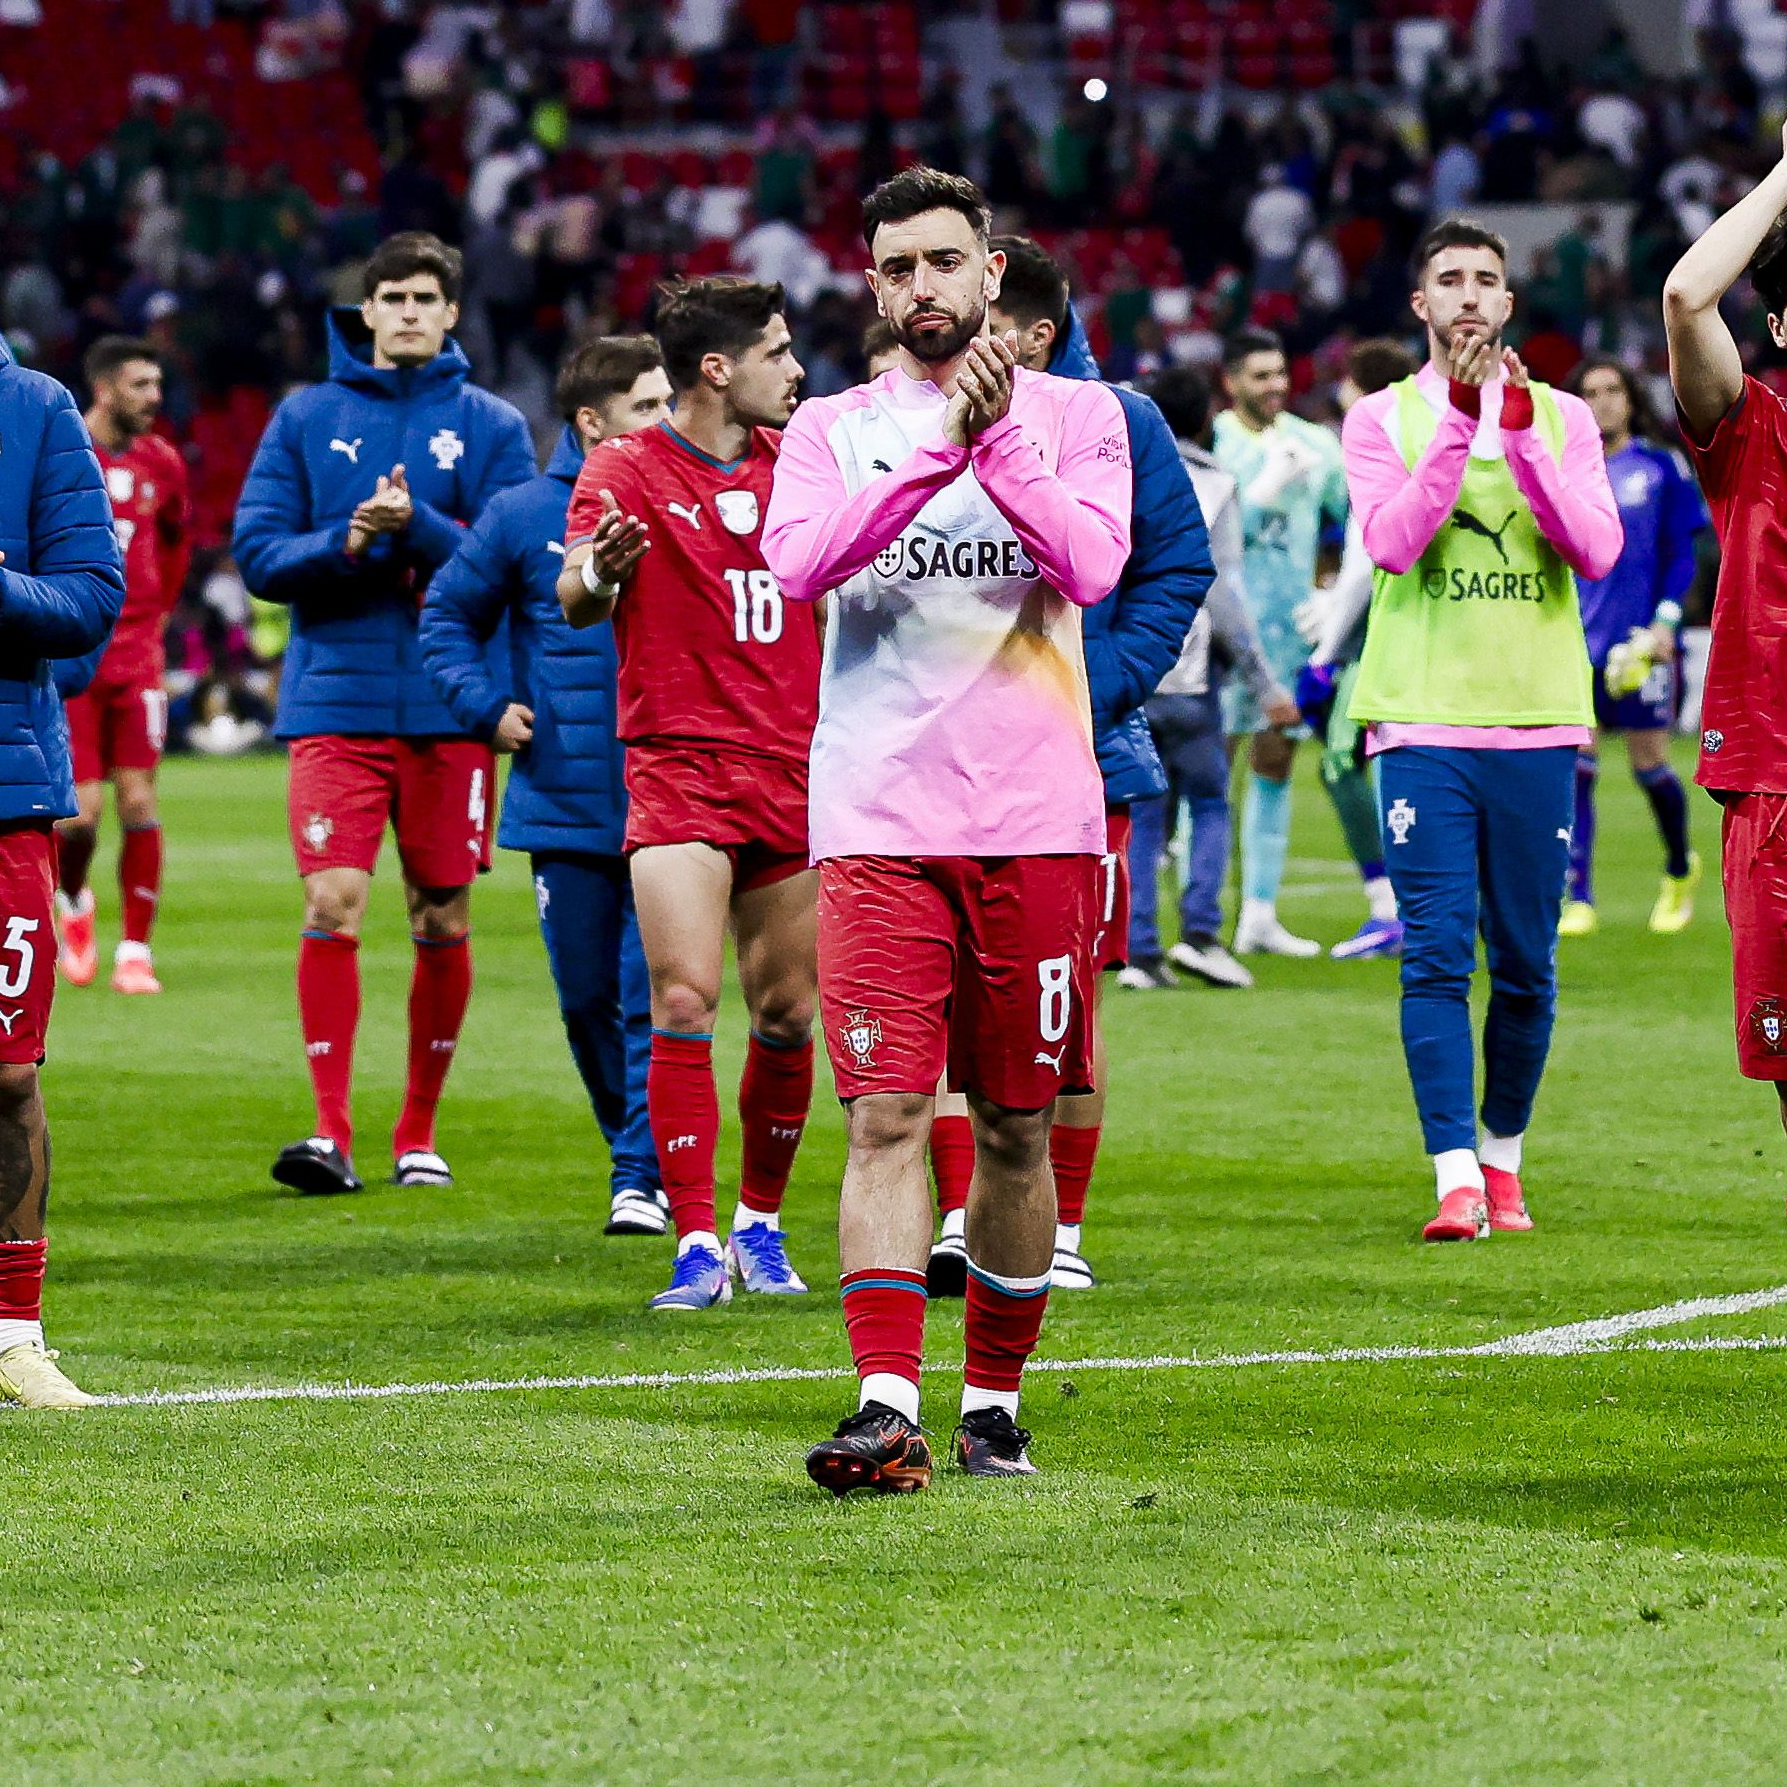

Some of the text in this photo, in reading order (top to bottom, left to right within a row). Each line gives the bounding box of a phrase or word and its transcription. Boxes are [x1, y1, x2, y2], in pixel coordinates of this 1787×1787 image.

[723, 568, 784, 644] 18
[1449, 567, 1545, 602] SAGRES
[1037, 953, 1072, 1043] 8
